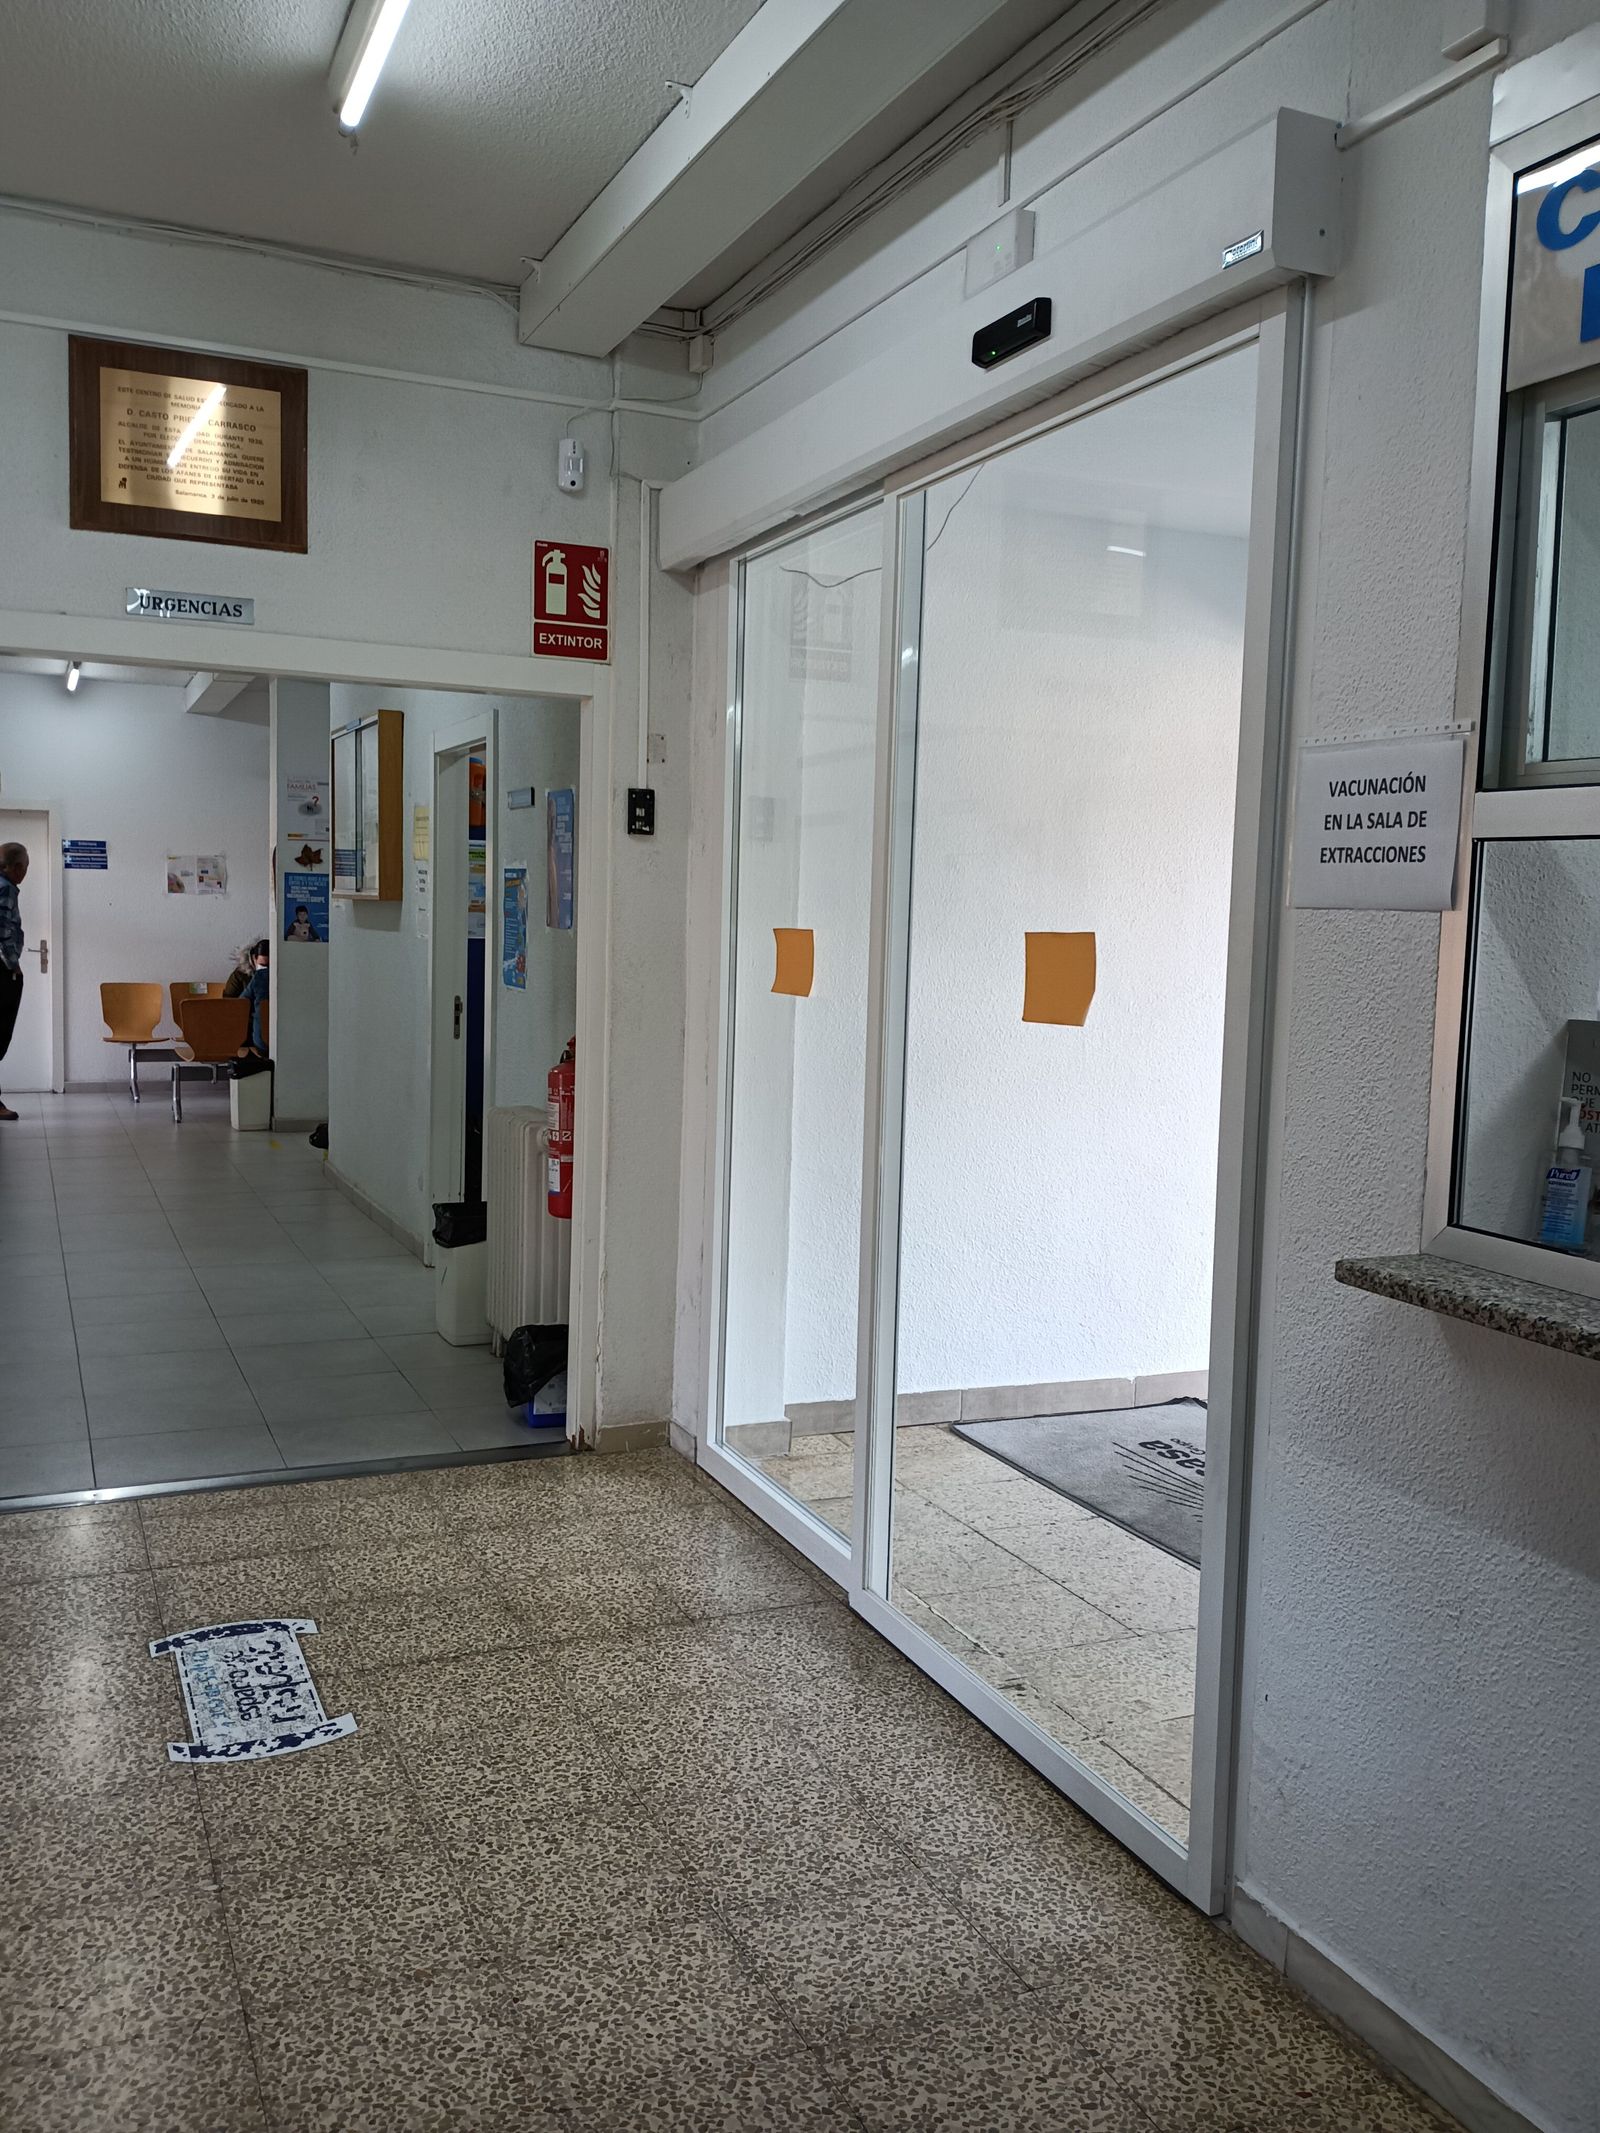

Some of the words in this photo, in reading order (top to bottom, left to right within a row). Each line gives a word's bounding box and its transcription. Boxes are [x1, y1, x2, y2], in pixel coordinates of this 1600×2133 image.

[118, 386, 133, 394] ESTE
[135, 389, 162, 398] CENTRO
[174, 394, 195, 402] SALUD
[217, 400, 248, 410] EDICADO
[138, 410, 169, 421] CASTO
[208, 419, 257, 432] CARRASCO
[118, 421, 148, 430] ALCALDE
[215, 433, 245, 442] DURANTE
[118, 446, 163, 457] TESTIMONIAR
[129, 440, 177, 451] AYUNTAMIENT
[197, 449, 238, 459] SALAMANCA
[242, 454, 264, 463] QUIERE
[118, 463, 148, 472] DEFENSA
[161, 467, 174, 475] LOS
[176, 469, 201, 478] AFANES
[214, 474, 244, 483] LIBERTAD
[146, 474, 171, 482] CIUDAD
[190, 479, 238, 490] REPRESENTABA
[233, 468, 248, 476] VIDA
[139, 595, 243, 618] URGENCIAS
[539, 632, 603, 649] EXTINTOR
[1328, 770, 1427, 798] VACUNACIÓN
[1323, 814, 1342, 831] EN
[1346, 813, 1363, 830] LA
[1366, 811, 1403, 830] SALA
[1407, 810, 1428, 828] DE
[1319, 845, 1427, 864] EXTRACCIONES
[1572, 1072, 1592, 1083] NO
[1549, 1168, 1577, 1181] Purell
[1138, 1440, 1206, 1477] asa
